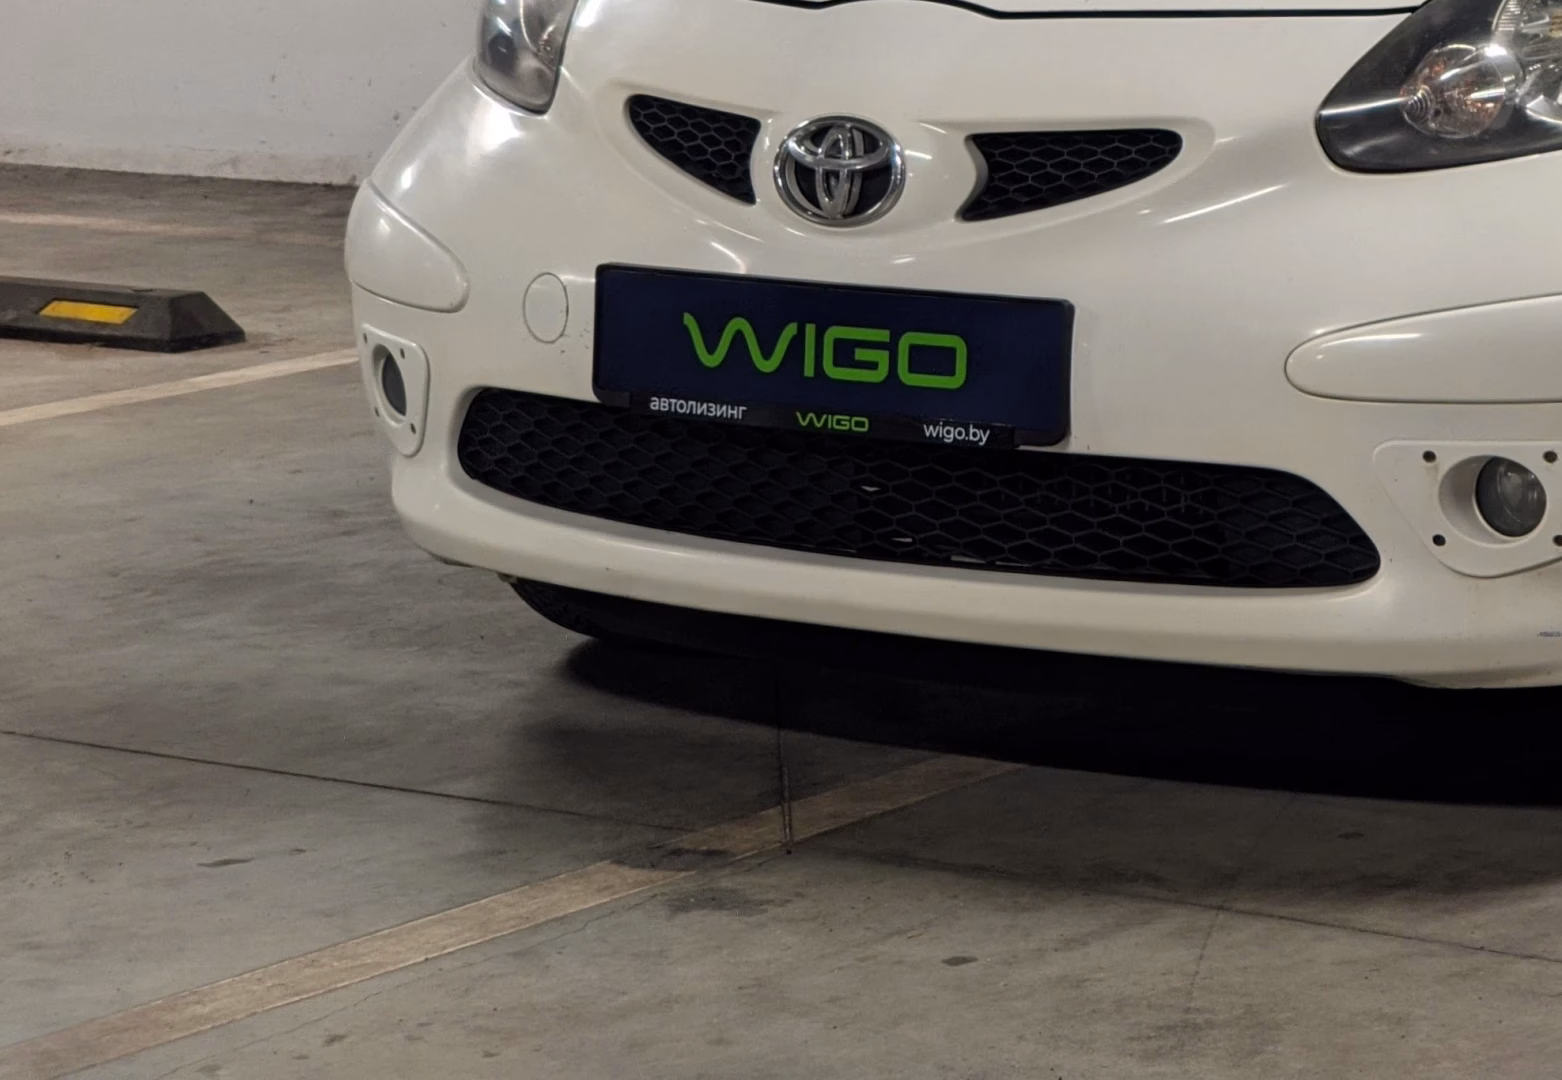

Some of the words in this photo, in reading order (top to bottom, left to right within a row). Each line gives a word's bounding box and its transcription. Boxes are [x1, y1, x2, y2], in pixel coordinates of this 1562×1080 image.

[683, 312, 968, 391] WIGO
[648, 395, 748, 421] автолизинг
[796, 411, 870, 433] WIGO
[923, 421, 991, 446] wigo.by
